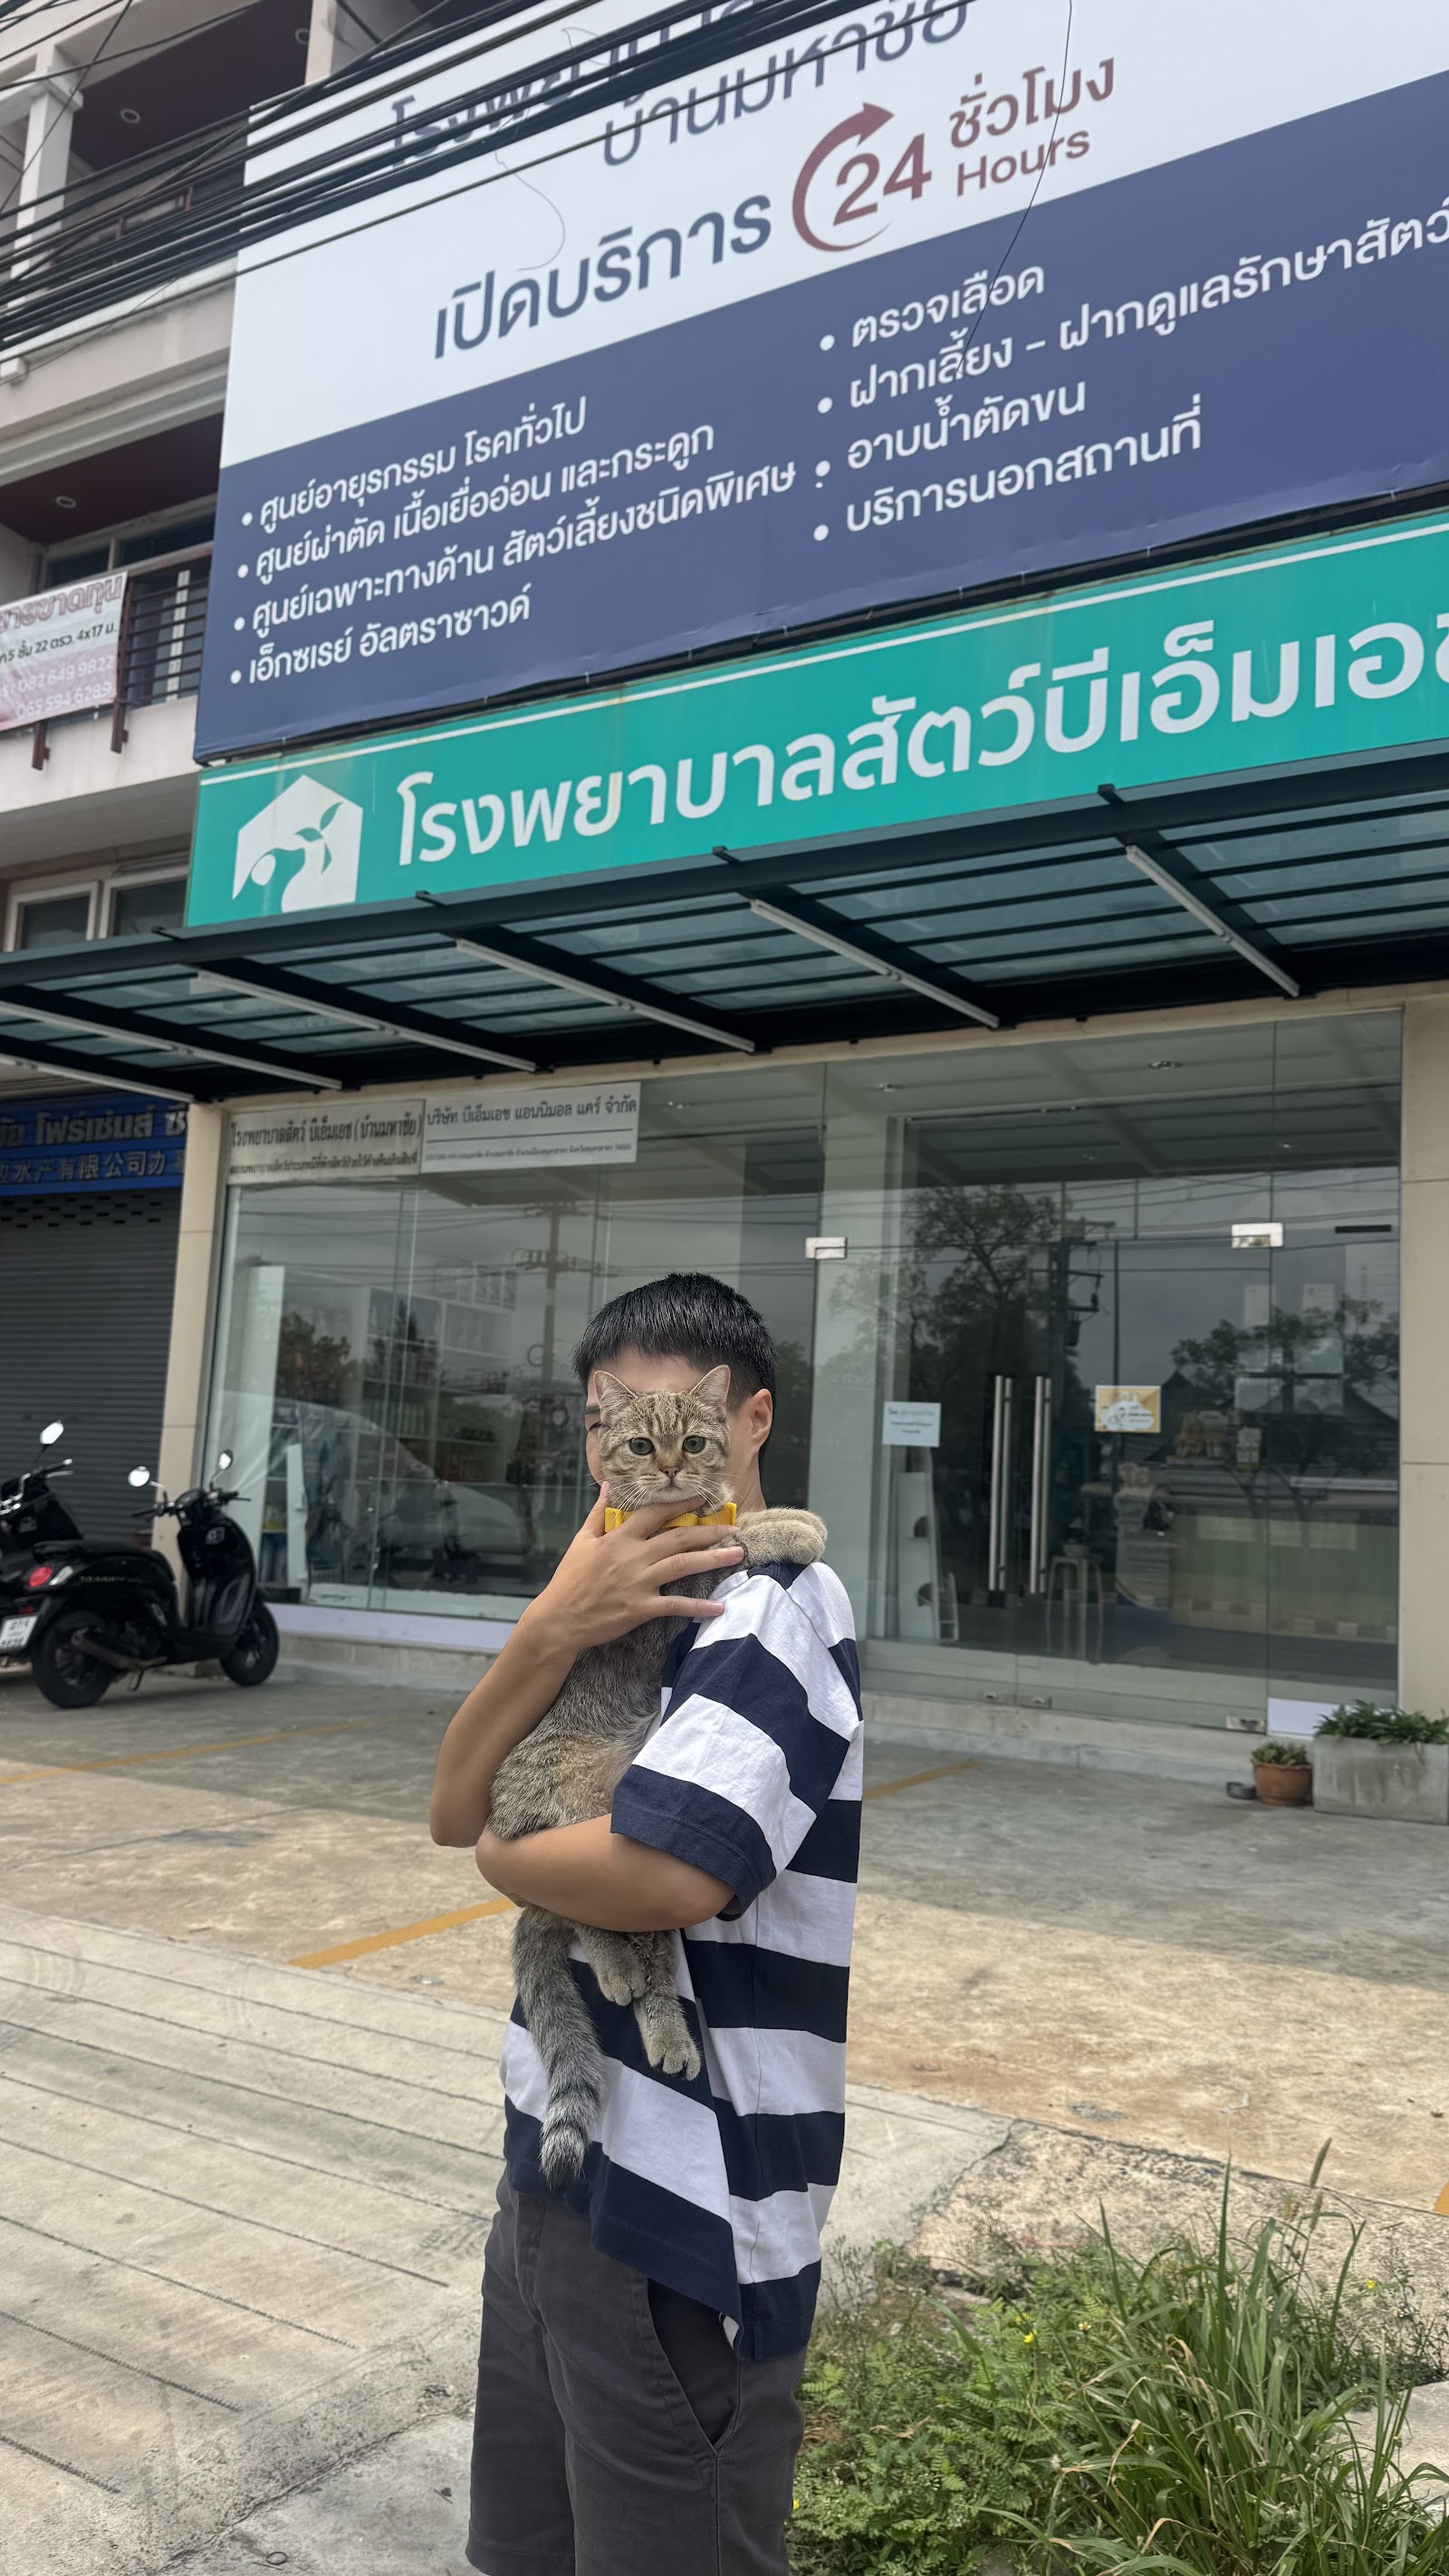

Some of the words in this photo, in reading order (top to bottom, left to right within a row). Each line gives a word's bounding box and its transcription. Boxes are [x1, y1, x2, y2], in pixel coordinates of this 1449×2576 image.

[949, 57, 1115, 149] ชั่วโมง
[832, 132, 933, 226] 24
[956, 130, 1090, 197] Hours
[434, 195, 772, 359] เปิดบริการ
[851, 265, 1045, 347] ตรวจเลือด
[849, 328, 1012, 409] ฝากเลี้ยง
[260, 446, 456, 534] ศูนย์อายุรกรรม
[465, 396, 587, 466] โรคทั่วไป
[846, 395, 1202, 532] บริการนอกสถานที่
[848, 380, 1086, 469] อาบน้ำตัดขน
[253, 544, 494, 639] ศูนย์เฉพาะทางด้าน
[504, 461, 797, 567] สัตว์เลี้ยงชนิดพิเศษ
[256, 517, 386, 585] ศูนย์ผ่าตัด
[394, 472, 552, 541] เนื้อเยื่ออ่อน
[561, 425, 715, 493] และกระดูก
[35, 639, 48, 654] 22
[249, 626, 354, 684] เอ็กซเรย์
[360, 582, 532, 658] อัลตราซาวด์
[397, 612, 1449, 866] โรงพยาบาลสัตว์บีเอ็มเอ
